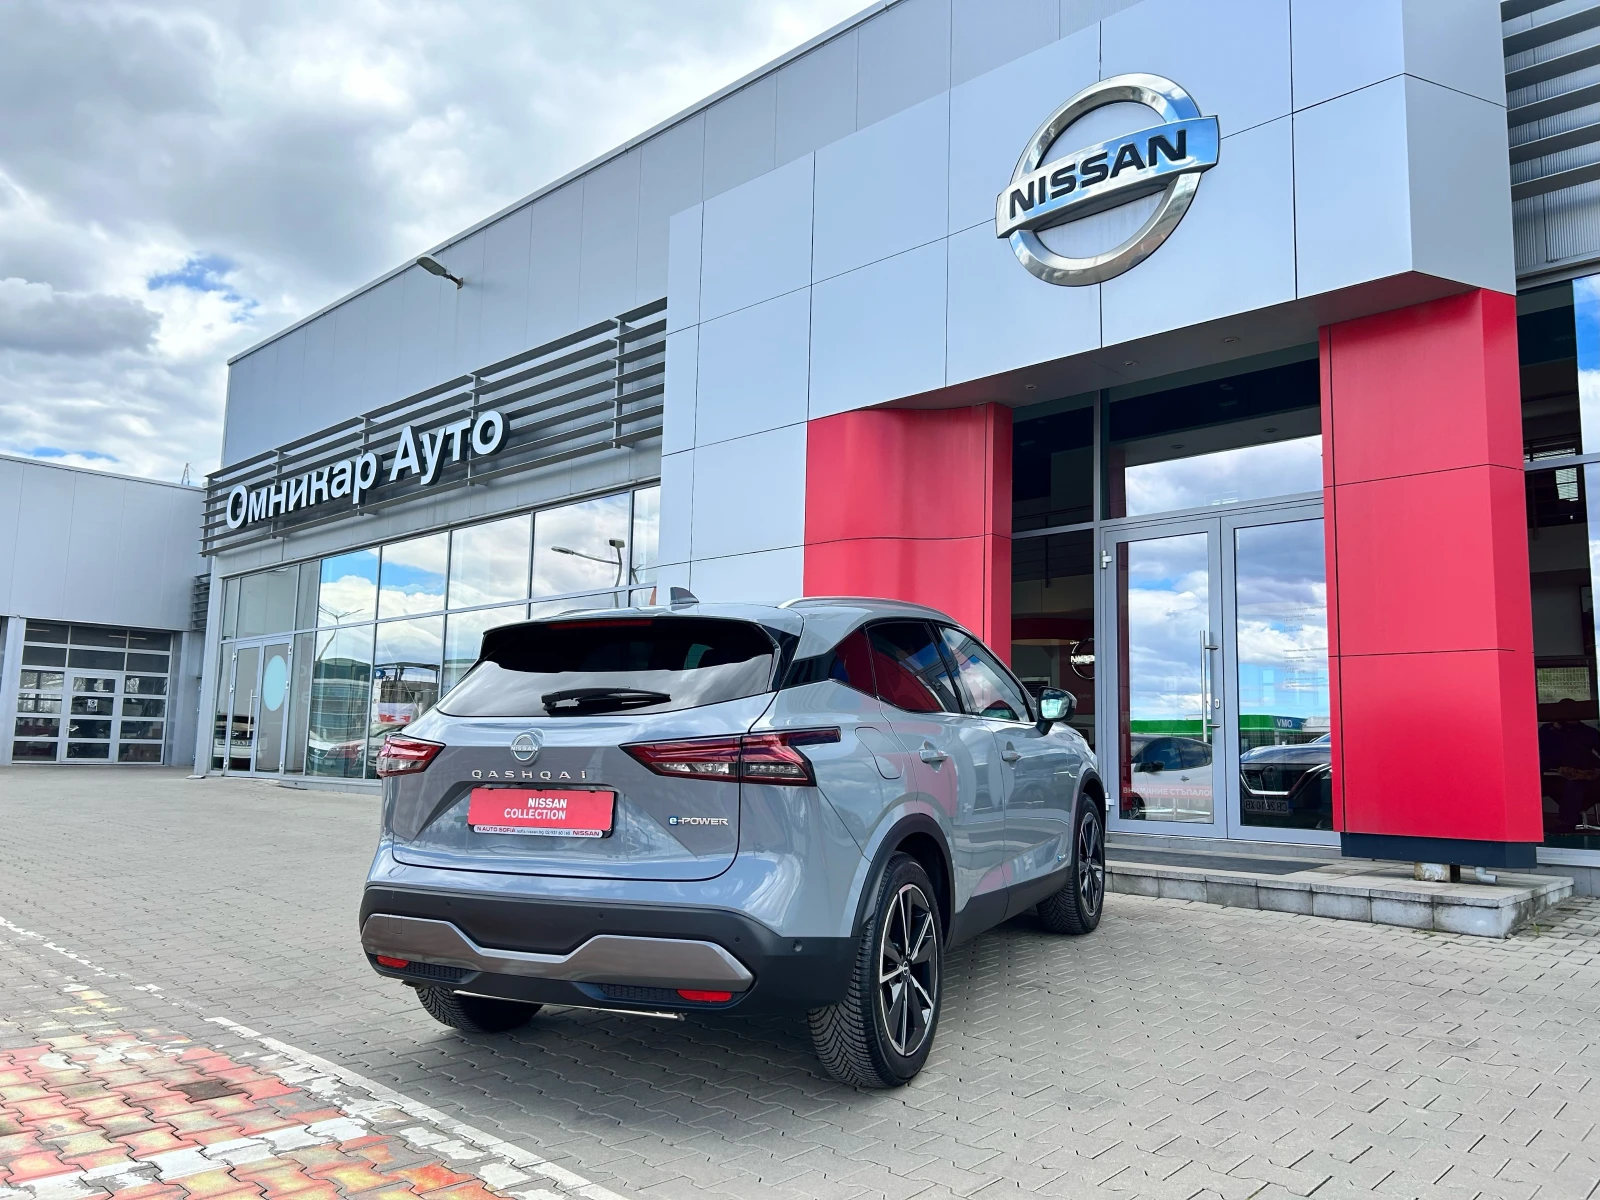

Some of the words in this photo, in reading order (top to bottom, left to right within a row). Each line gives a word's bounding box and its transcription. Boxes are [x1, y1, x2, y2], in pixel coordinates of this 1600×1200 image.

[1009, 129, 1187, 220] NISSAN
[226, 452, 380, 530] Омникар
[389, 410, 507, 486] Ауто
[1122, 786, 1168, 796] ВНИМАНИЕ
[527, 797, 568, 809] NISSAN
[504, 808, 567, 820] COLLECTION
[669, 816, 729, 826] e-POWER
